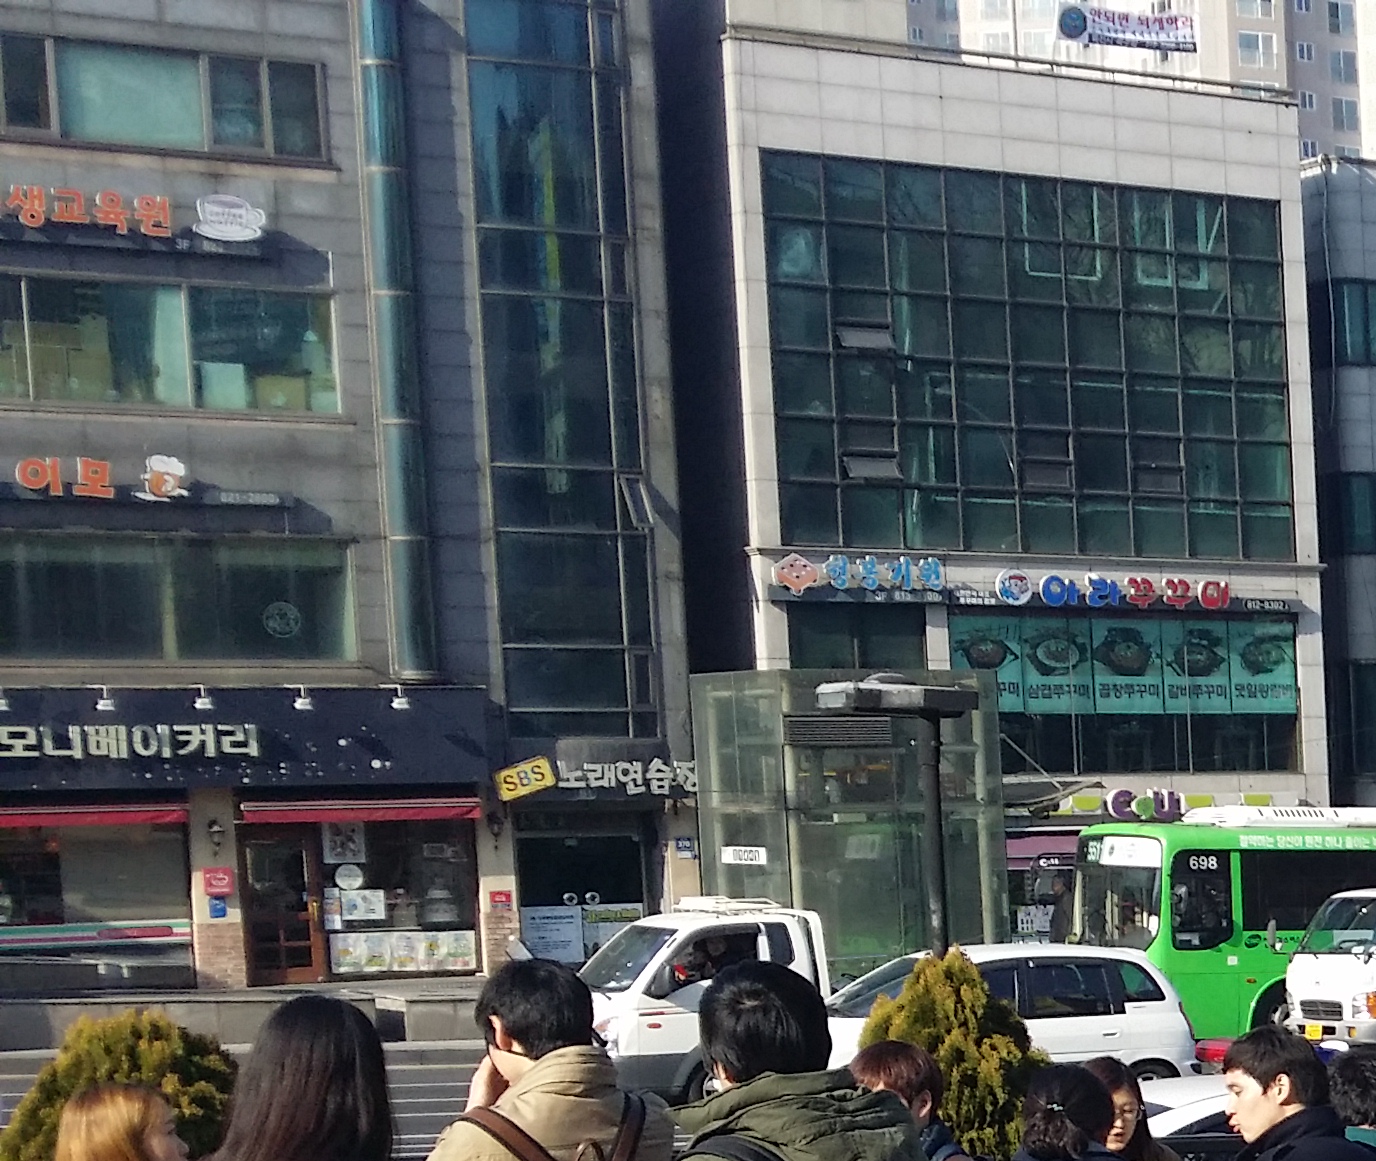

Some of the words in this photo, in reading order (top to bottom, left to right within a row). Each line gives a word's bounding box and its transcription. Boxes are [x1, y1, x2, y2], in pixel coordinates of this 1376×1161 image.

[8, 184, 172, 238] 생교육원
[0, 724, 259, 759] 모니베이커리
[503, 764, 546, 792] SBS
[1188, 854, 1218, 871] 698
